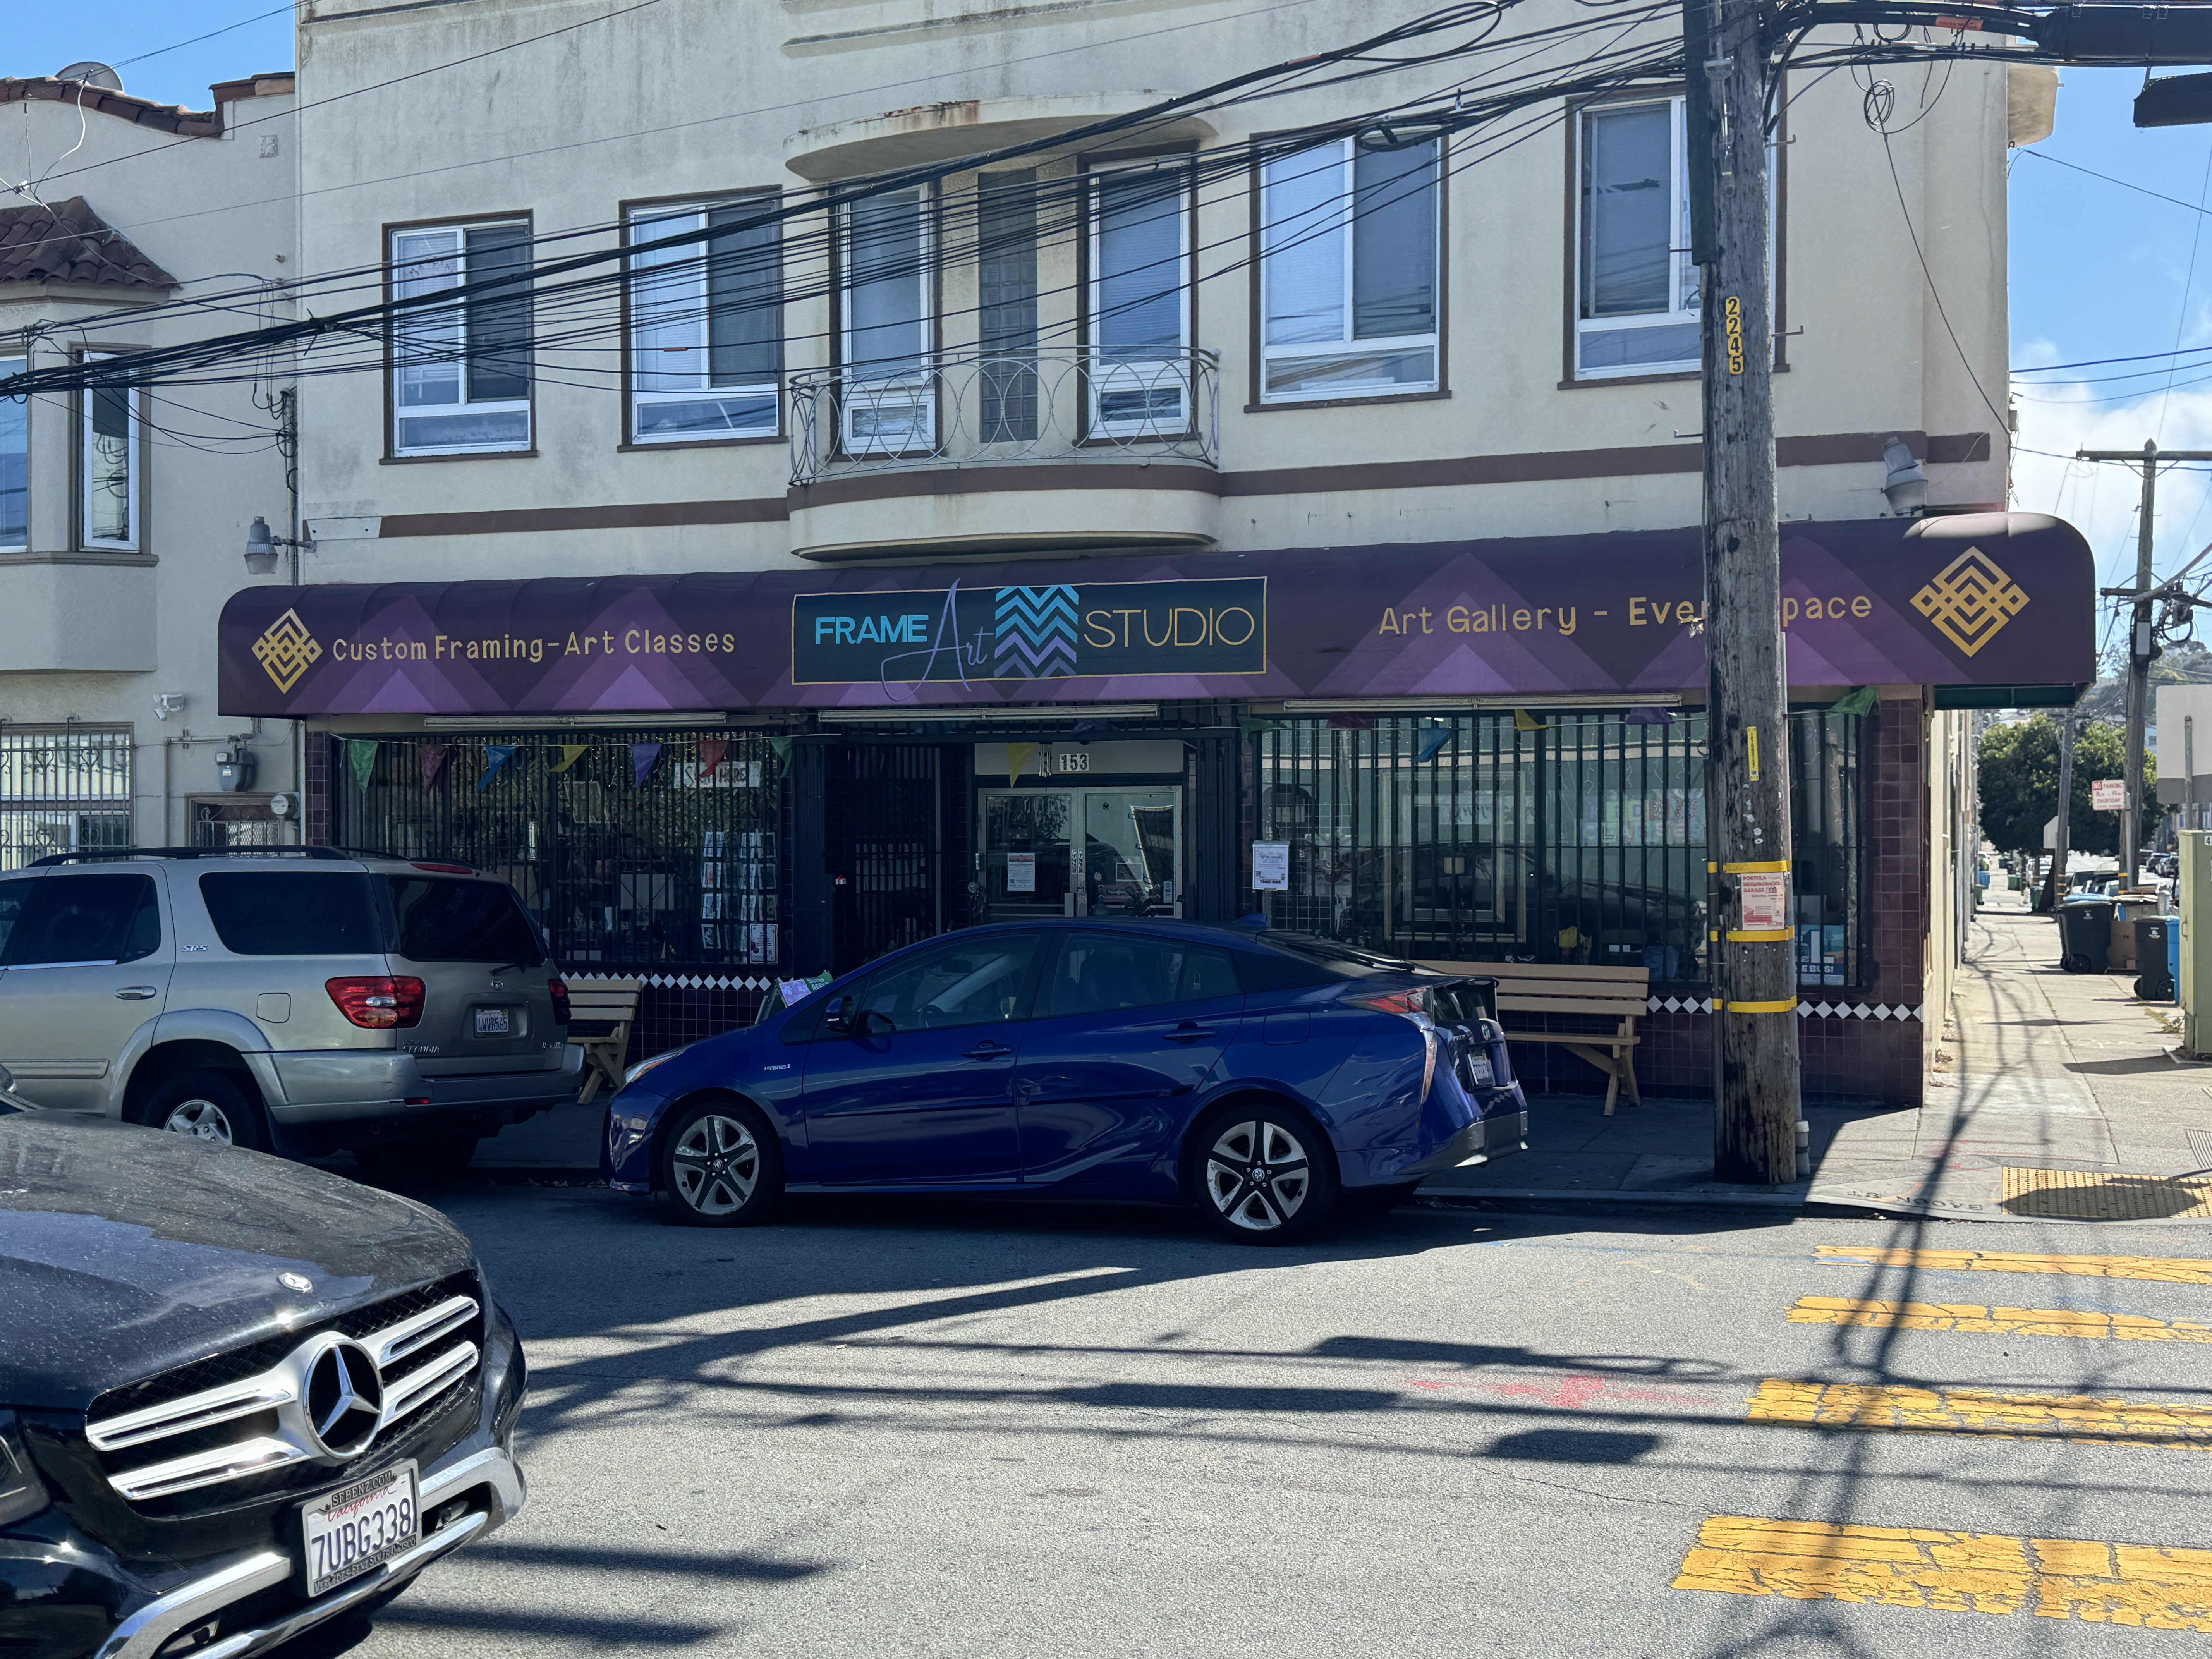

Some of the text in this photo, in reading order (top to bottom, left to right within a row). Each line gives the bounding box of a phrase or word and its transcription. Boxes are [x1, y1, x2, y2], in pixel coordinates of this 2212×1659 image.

[1728, 298, 1741, 372] 2245
[1379, 606, 1433, 635] Art
[1446, 604, 1576, 636] Gallery
[1629, 596, 1710, 626] Eve
[1783, 595, 1872, 627] pace
[333, 638, 427, 661] Custom
[624, 629, 735, 654] Classes
[815, 577, 1254, 702] FRAME Art STUDIO
[1061, 754, 1089, 771] 153
[2093, 781, 2102, 790] NO
[332, 1470, 393, 1506] SFBENZ.COM
[311, 1497, 412, 1576] 7UBG338
